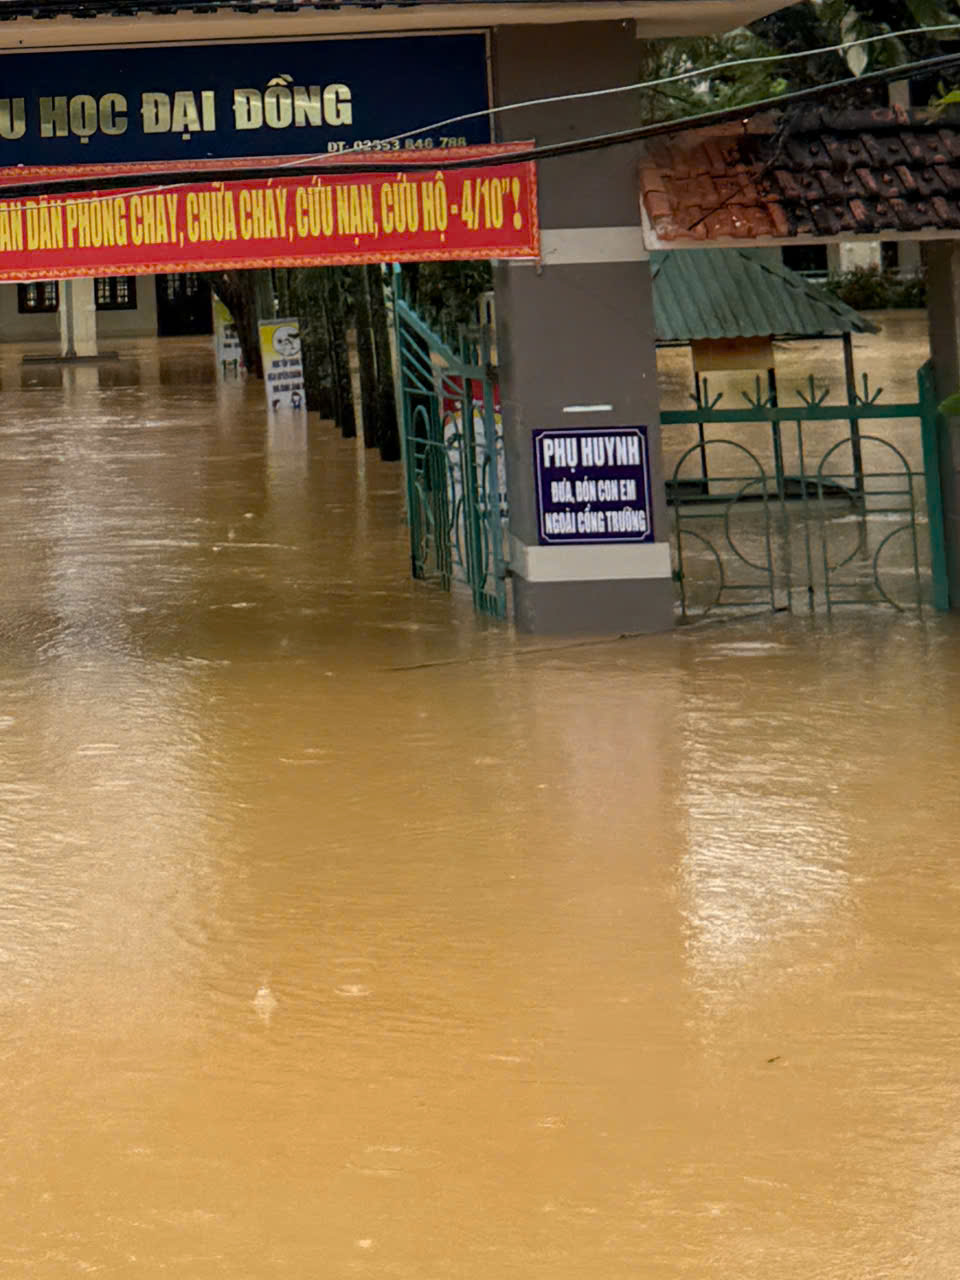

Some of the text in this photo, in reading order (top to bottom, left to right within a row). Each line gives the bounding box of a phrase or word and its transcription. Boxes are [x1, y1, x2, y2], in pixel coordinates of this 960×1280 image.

[39, 93, 128, 144] HỌC
[140, 90, 216, 140] ĐẠI
[232, 74, 353, 131] ĐỒNG
[186, 181, 237, 243] CHỮA
[240, 178, 294, 244] CHÁY,
[295, 175, 333, 238] CỨU
[336, 184, 379, 246] NẠN,
[380, 172, 419, 234] CỨU
[422, 170, 449, 242] HỘ
[451, 204, 459, 215] -
[543, 436, 640, 473] PHỤ HUYNH
[597, 479, 619, 502] CON
[620, 479, 637, 501] EM
